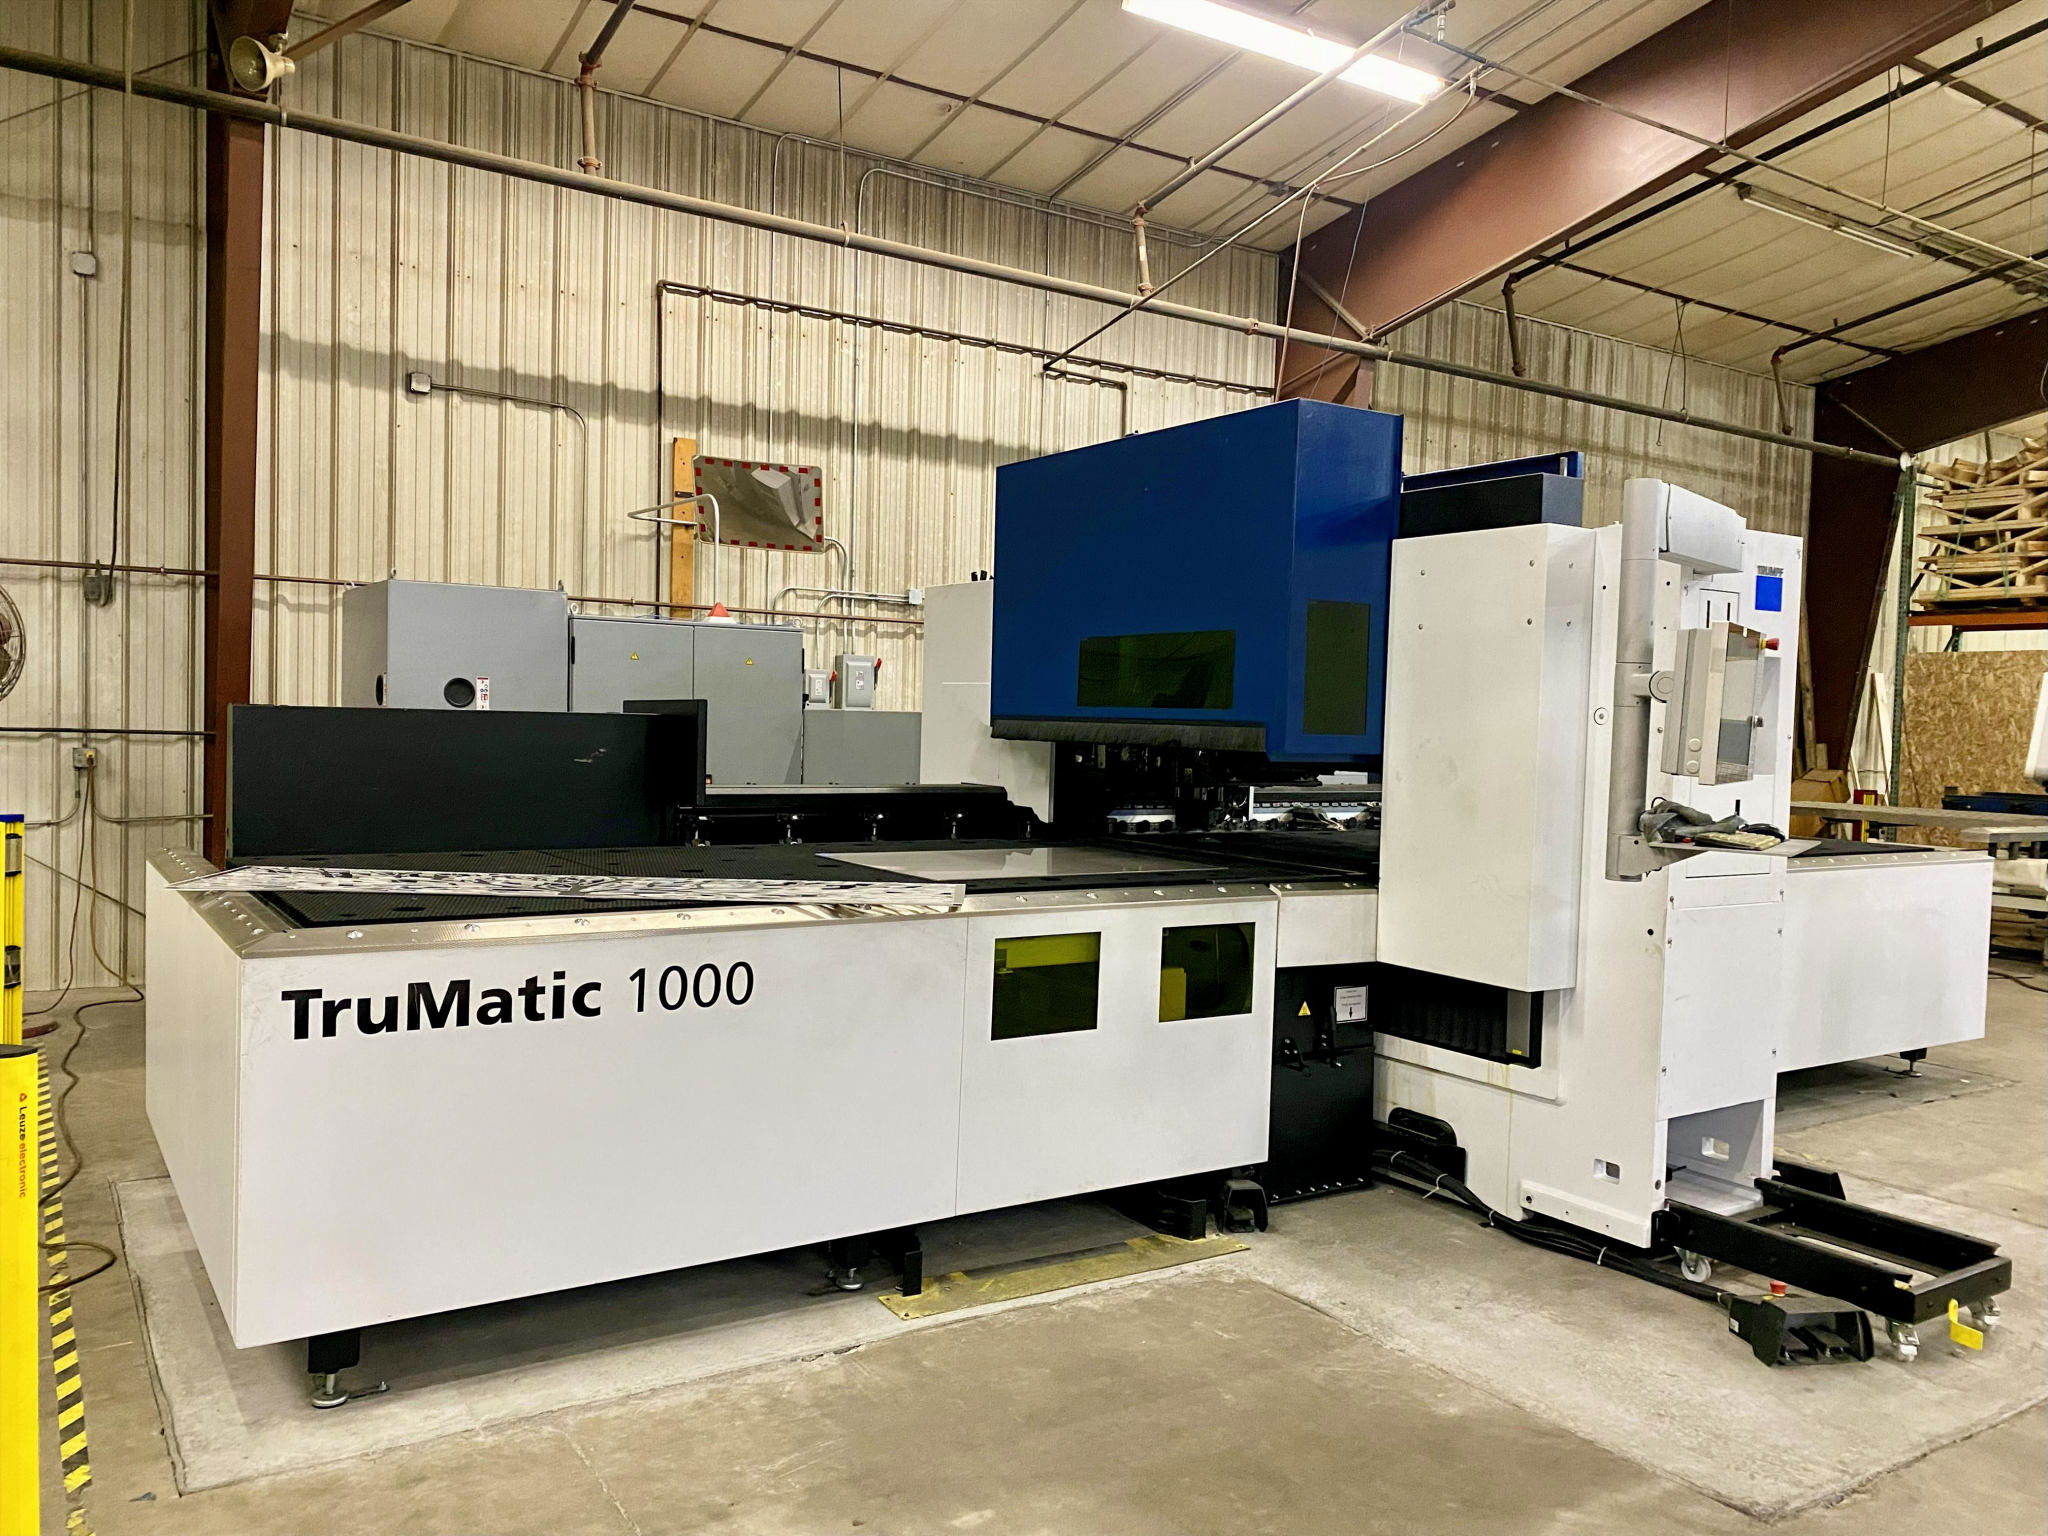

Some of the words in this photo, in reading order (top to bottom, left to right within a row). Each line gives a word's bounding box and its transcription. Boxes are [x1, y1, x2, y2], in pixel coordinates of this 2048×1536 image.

[281, 970, 602, 1040] TruMatic
[628, 961, 755, 1013] 1000
[19, 1105, 27, 1141] Leuze
[19, 1142, 27, 1199] electronic
